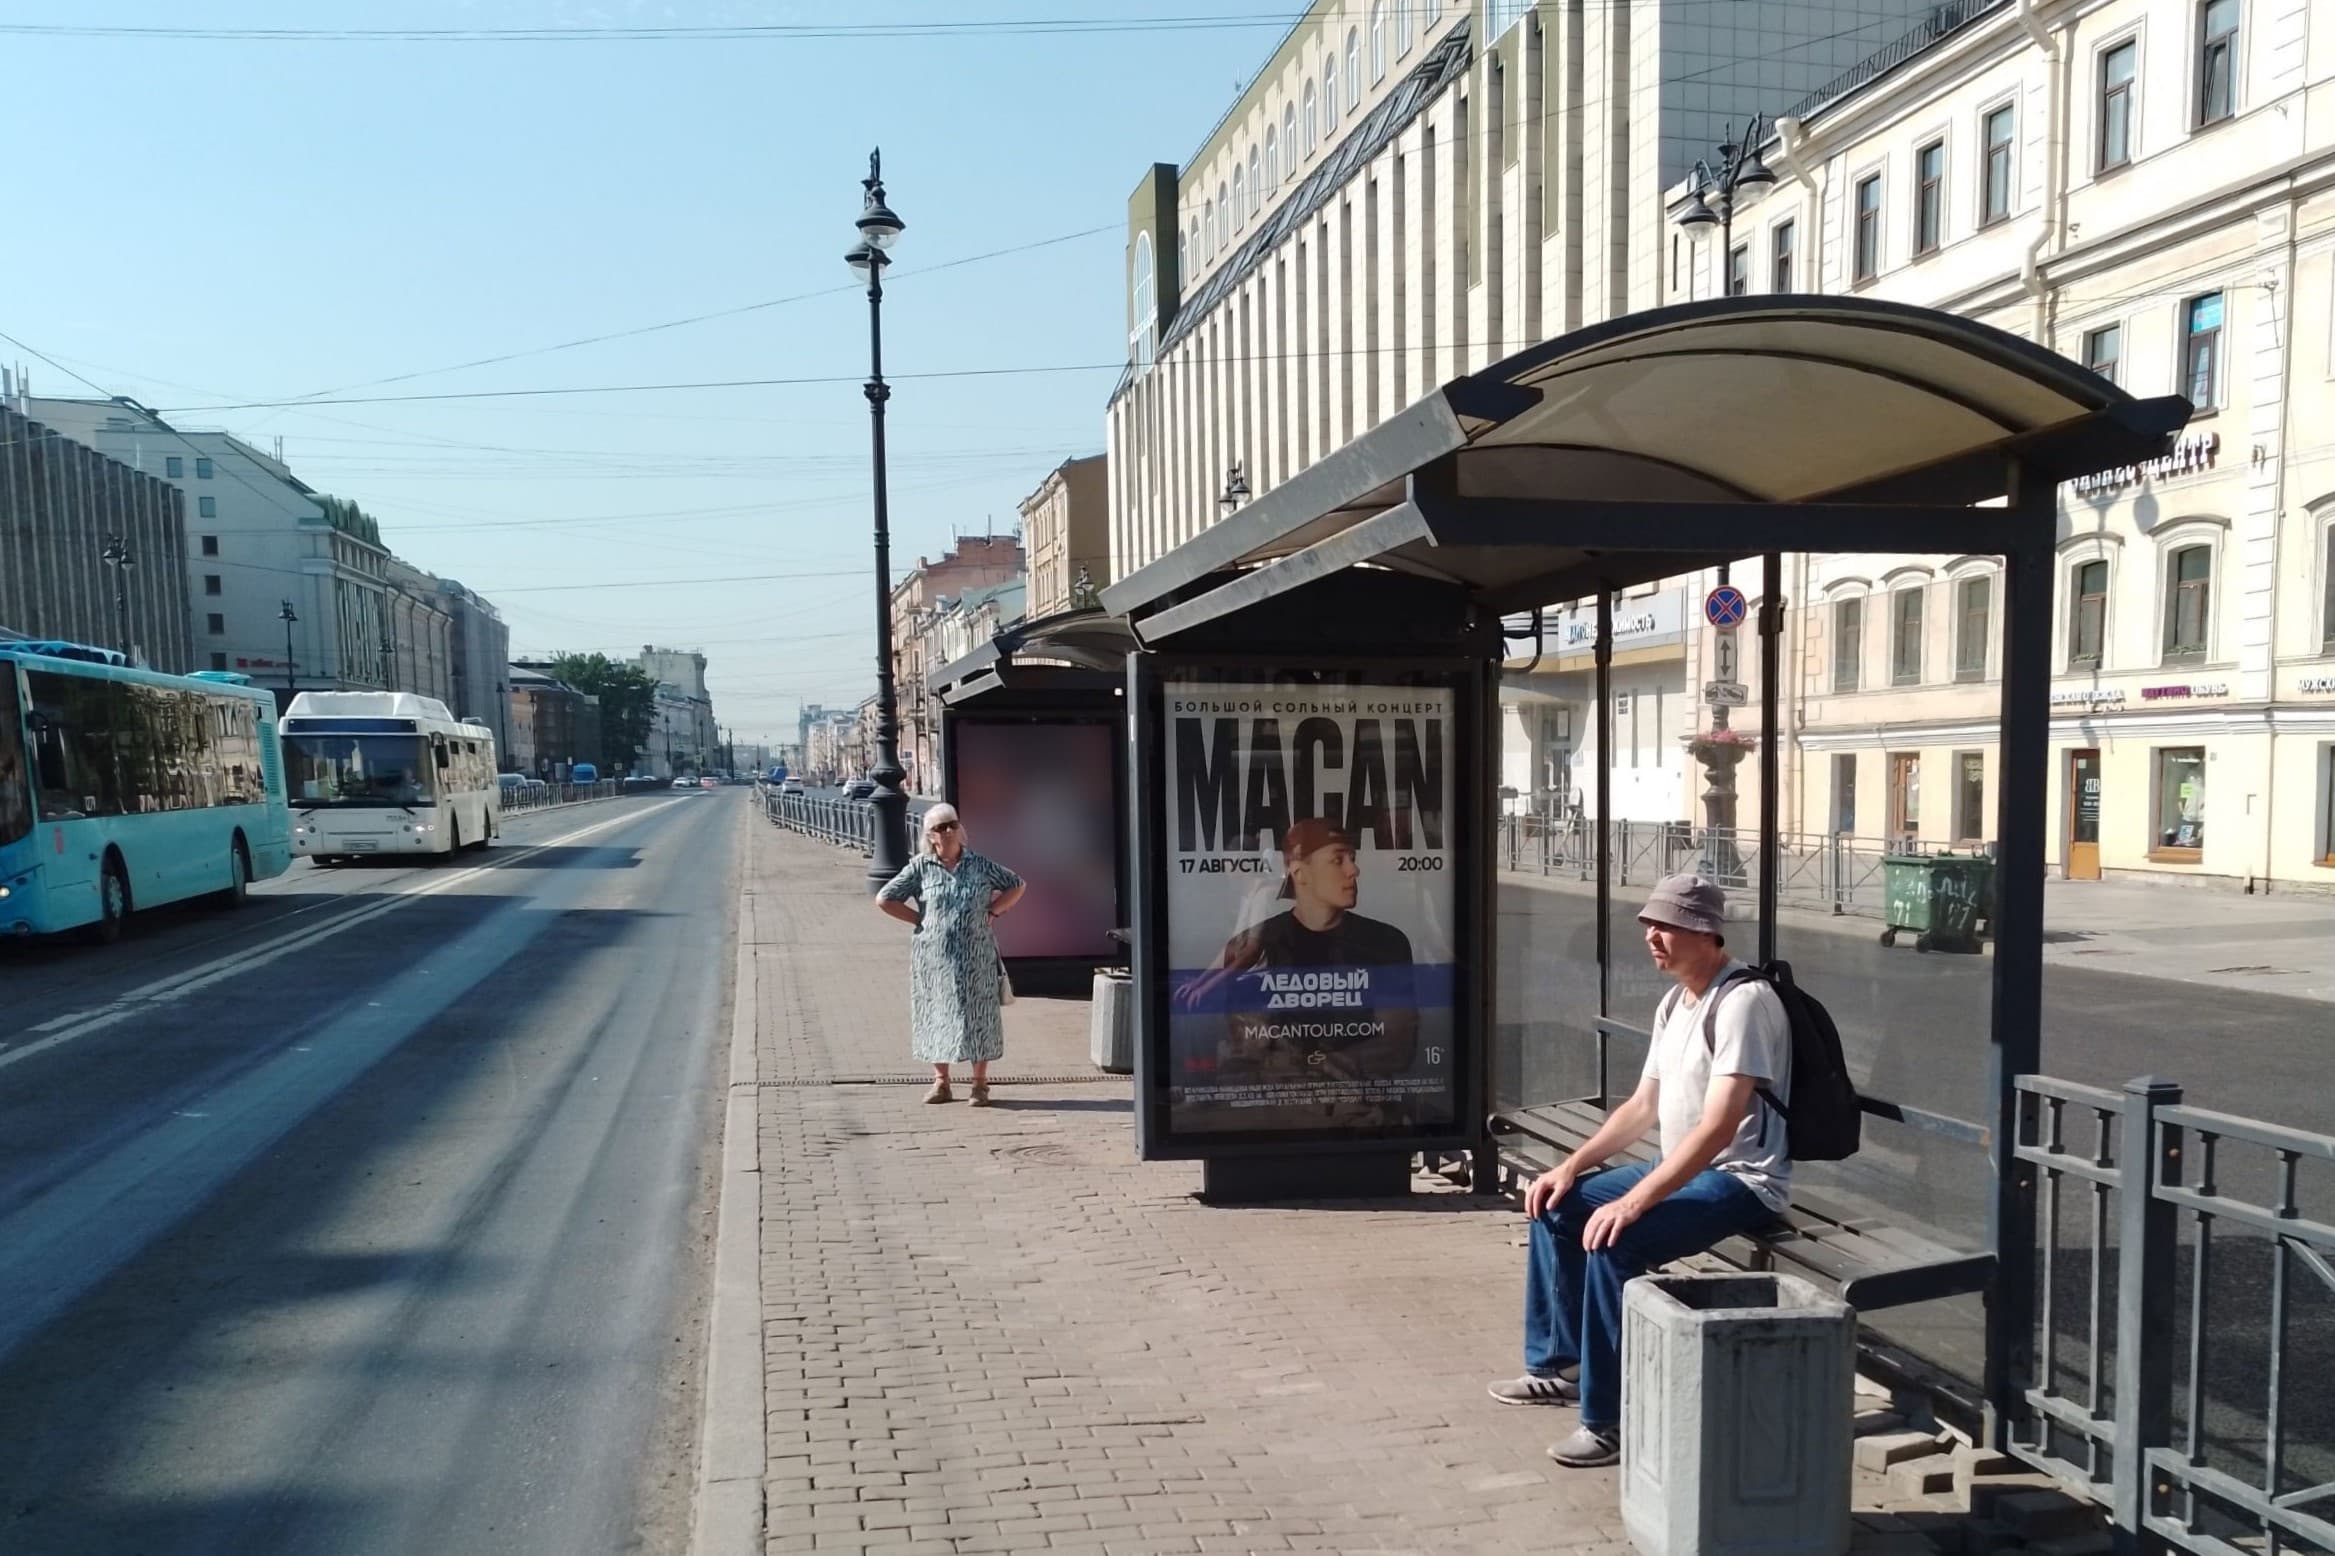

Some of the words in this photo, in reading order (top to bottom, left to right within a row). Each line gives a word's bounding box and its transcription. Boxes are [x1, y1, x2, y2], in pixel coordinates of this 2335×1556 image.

[1174, 699, 1263, 713] БОЛЬШОЙ
[1272, 699, 1358, 714] СОЛЬНЫЙ
[1367, 702, 1444, 716] КОНЦЕРТ
[1175, 717, 1444, 852] MACAN
[1180, 859, 1195, 874] 17
[1199, 858, 1273, 874] АВГУСТА
[1398, 856, 1444, 872] 20:00
[1260, 968, 1369, 992] ЛЕДОВЫЙ
[1267, 991, 1363, 1009] ДВОРЕЦ
[1244, 1022, 1385, 1040] MACANTOUR.COM
